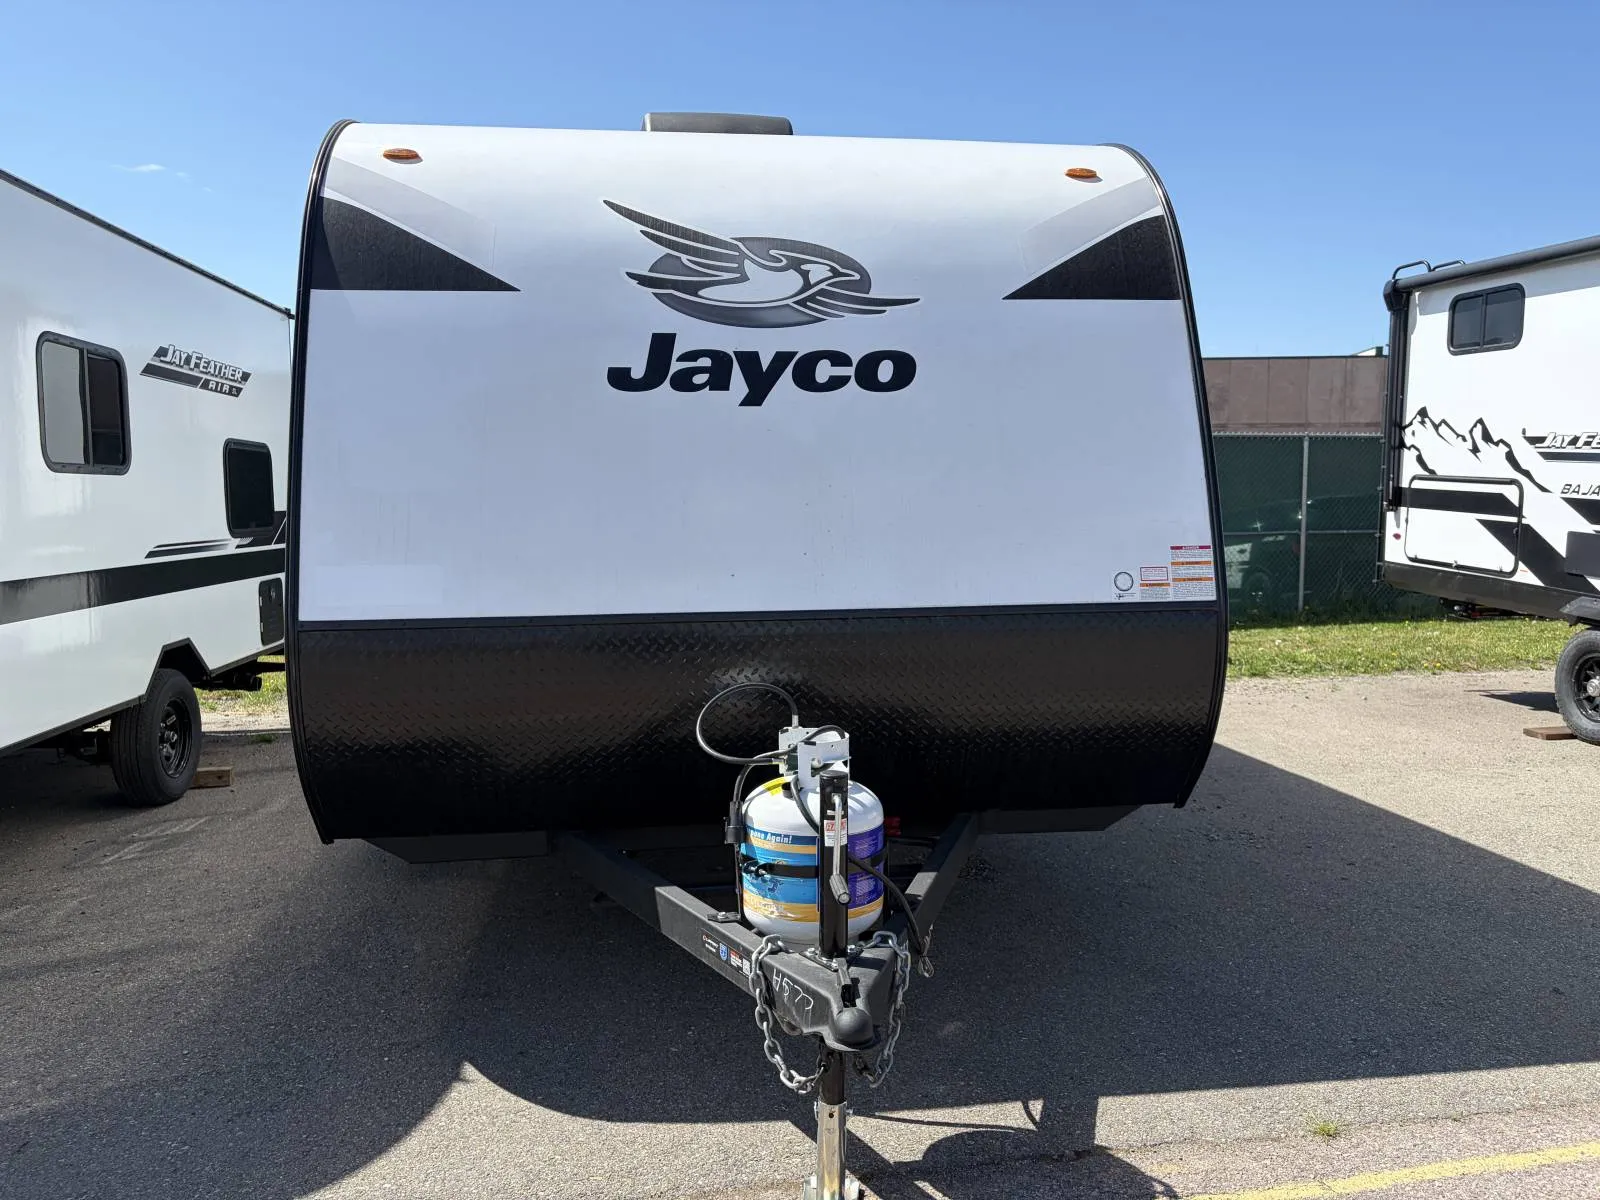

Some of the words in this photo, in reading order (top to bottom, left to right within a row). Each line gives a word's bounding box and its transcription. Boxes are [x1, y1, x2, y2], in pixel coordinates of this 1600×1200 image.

[160, 343, 188, 366] JAY
[189, 351, 244, 381] FEATHER
[607, 332, 917, 407] Jayco
[208, 381, 230, 394] AIR
[1535, 431, 1576, 449] JAY
[1560, 483, 1600, 496] BAJA
[766, 833, 793, 844] Again!
